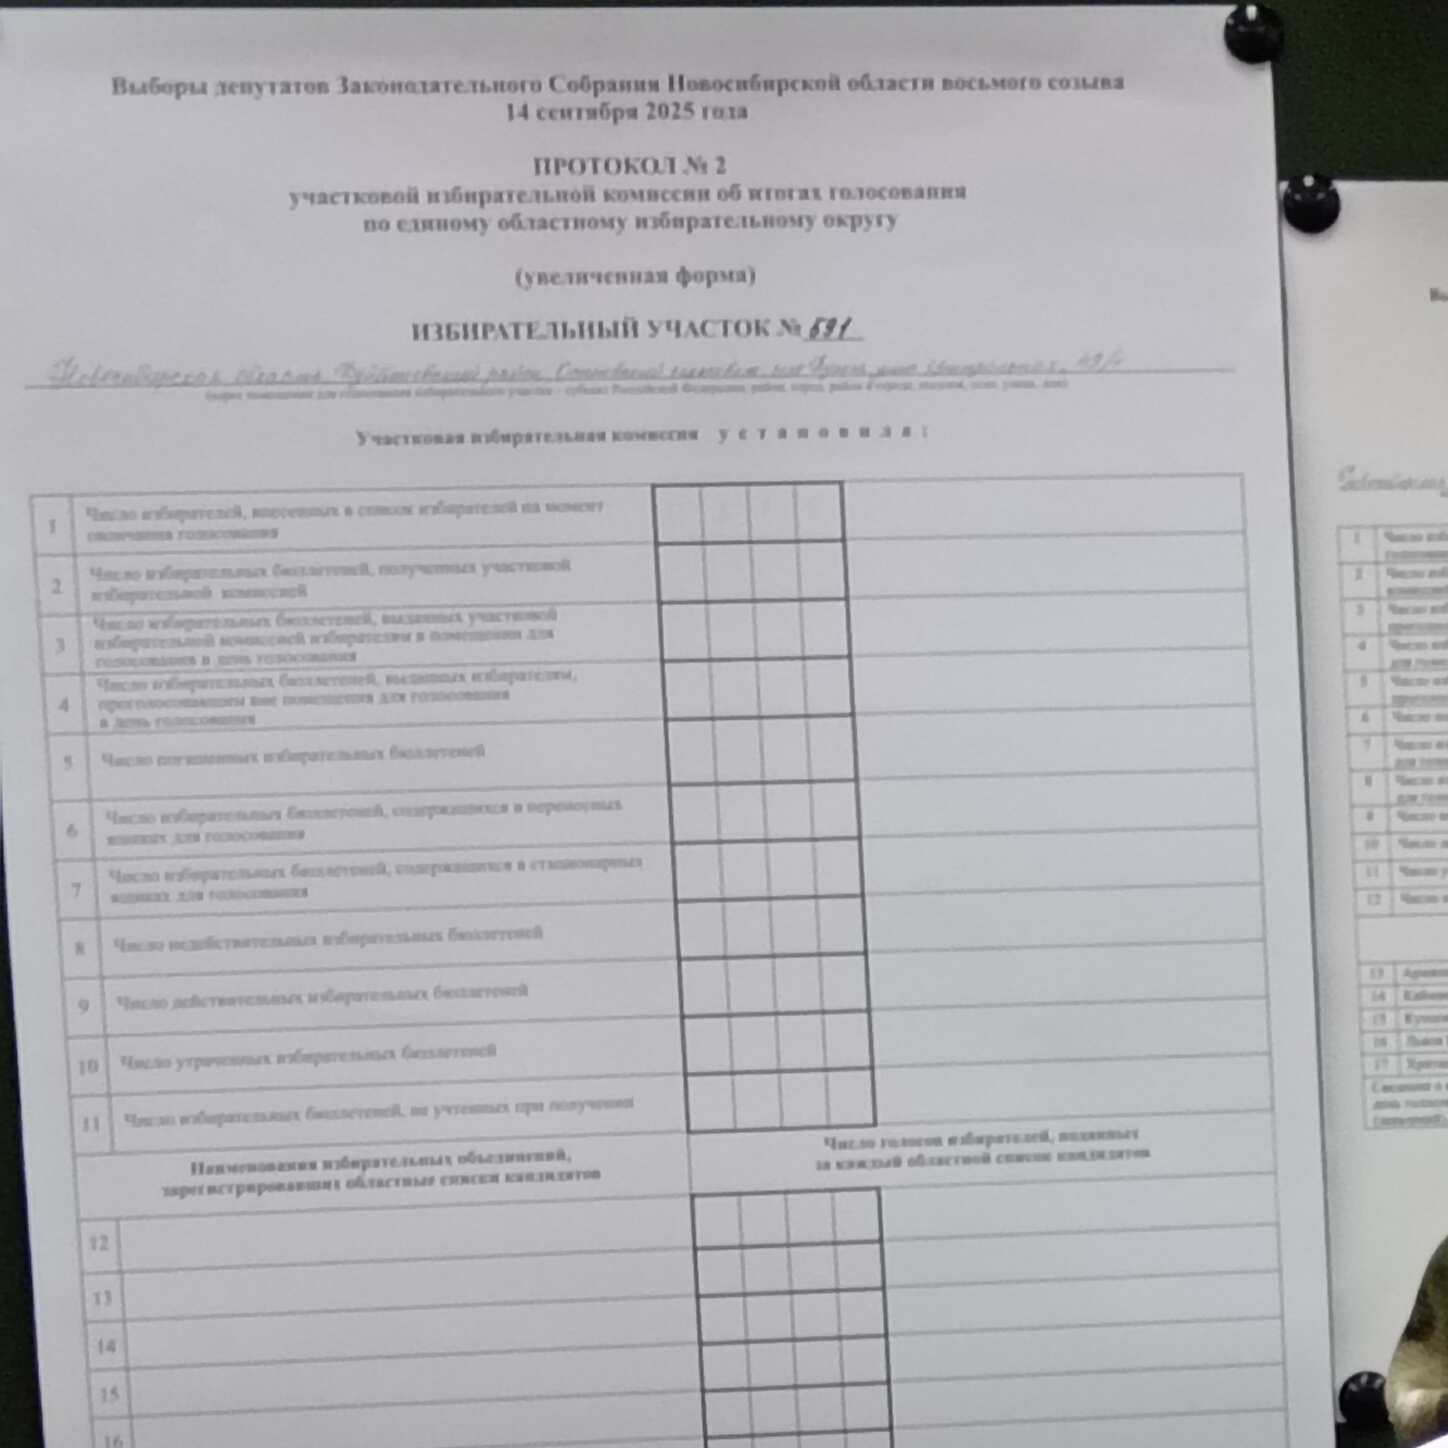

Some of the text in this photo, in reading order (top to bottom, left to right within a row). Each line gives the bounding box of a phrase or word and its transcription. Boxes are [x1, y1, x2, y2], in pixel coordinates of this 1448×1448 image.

[111, 75, 208, 101] Выборы
[214, 78, 330, 101] депутатов
[548, 73, 660, 98] Собрания
[847, 72, 935, 92] области
[941, 75, 1042, 92] восьмого
[1047, 76, 1125, 91] созыва
[507, 99, 749, 127] 14 сентября 2025 года
[533, 155, 727, 177] ПРОТОКОЛ № 2
[289, 185, 420, 209] участковой
[602, 187, 711, 204] комиссии
[716, 182, 742, 203] об
[748, 185, 822, 203] итогах
[828, 184, 967, 202] голосования
[363, 217, 391, 233] по
[396, 216, 489, 238] единому
[497, 211, 626, 235] областному
[822, 212, 897, 235] округу
[675, 264, 757, 290] форма)
[648, 317, 770, 340] УЧАСТОК
[776, 318, 802, 340] №
[807, 316, 854, 341] 591
